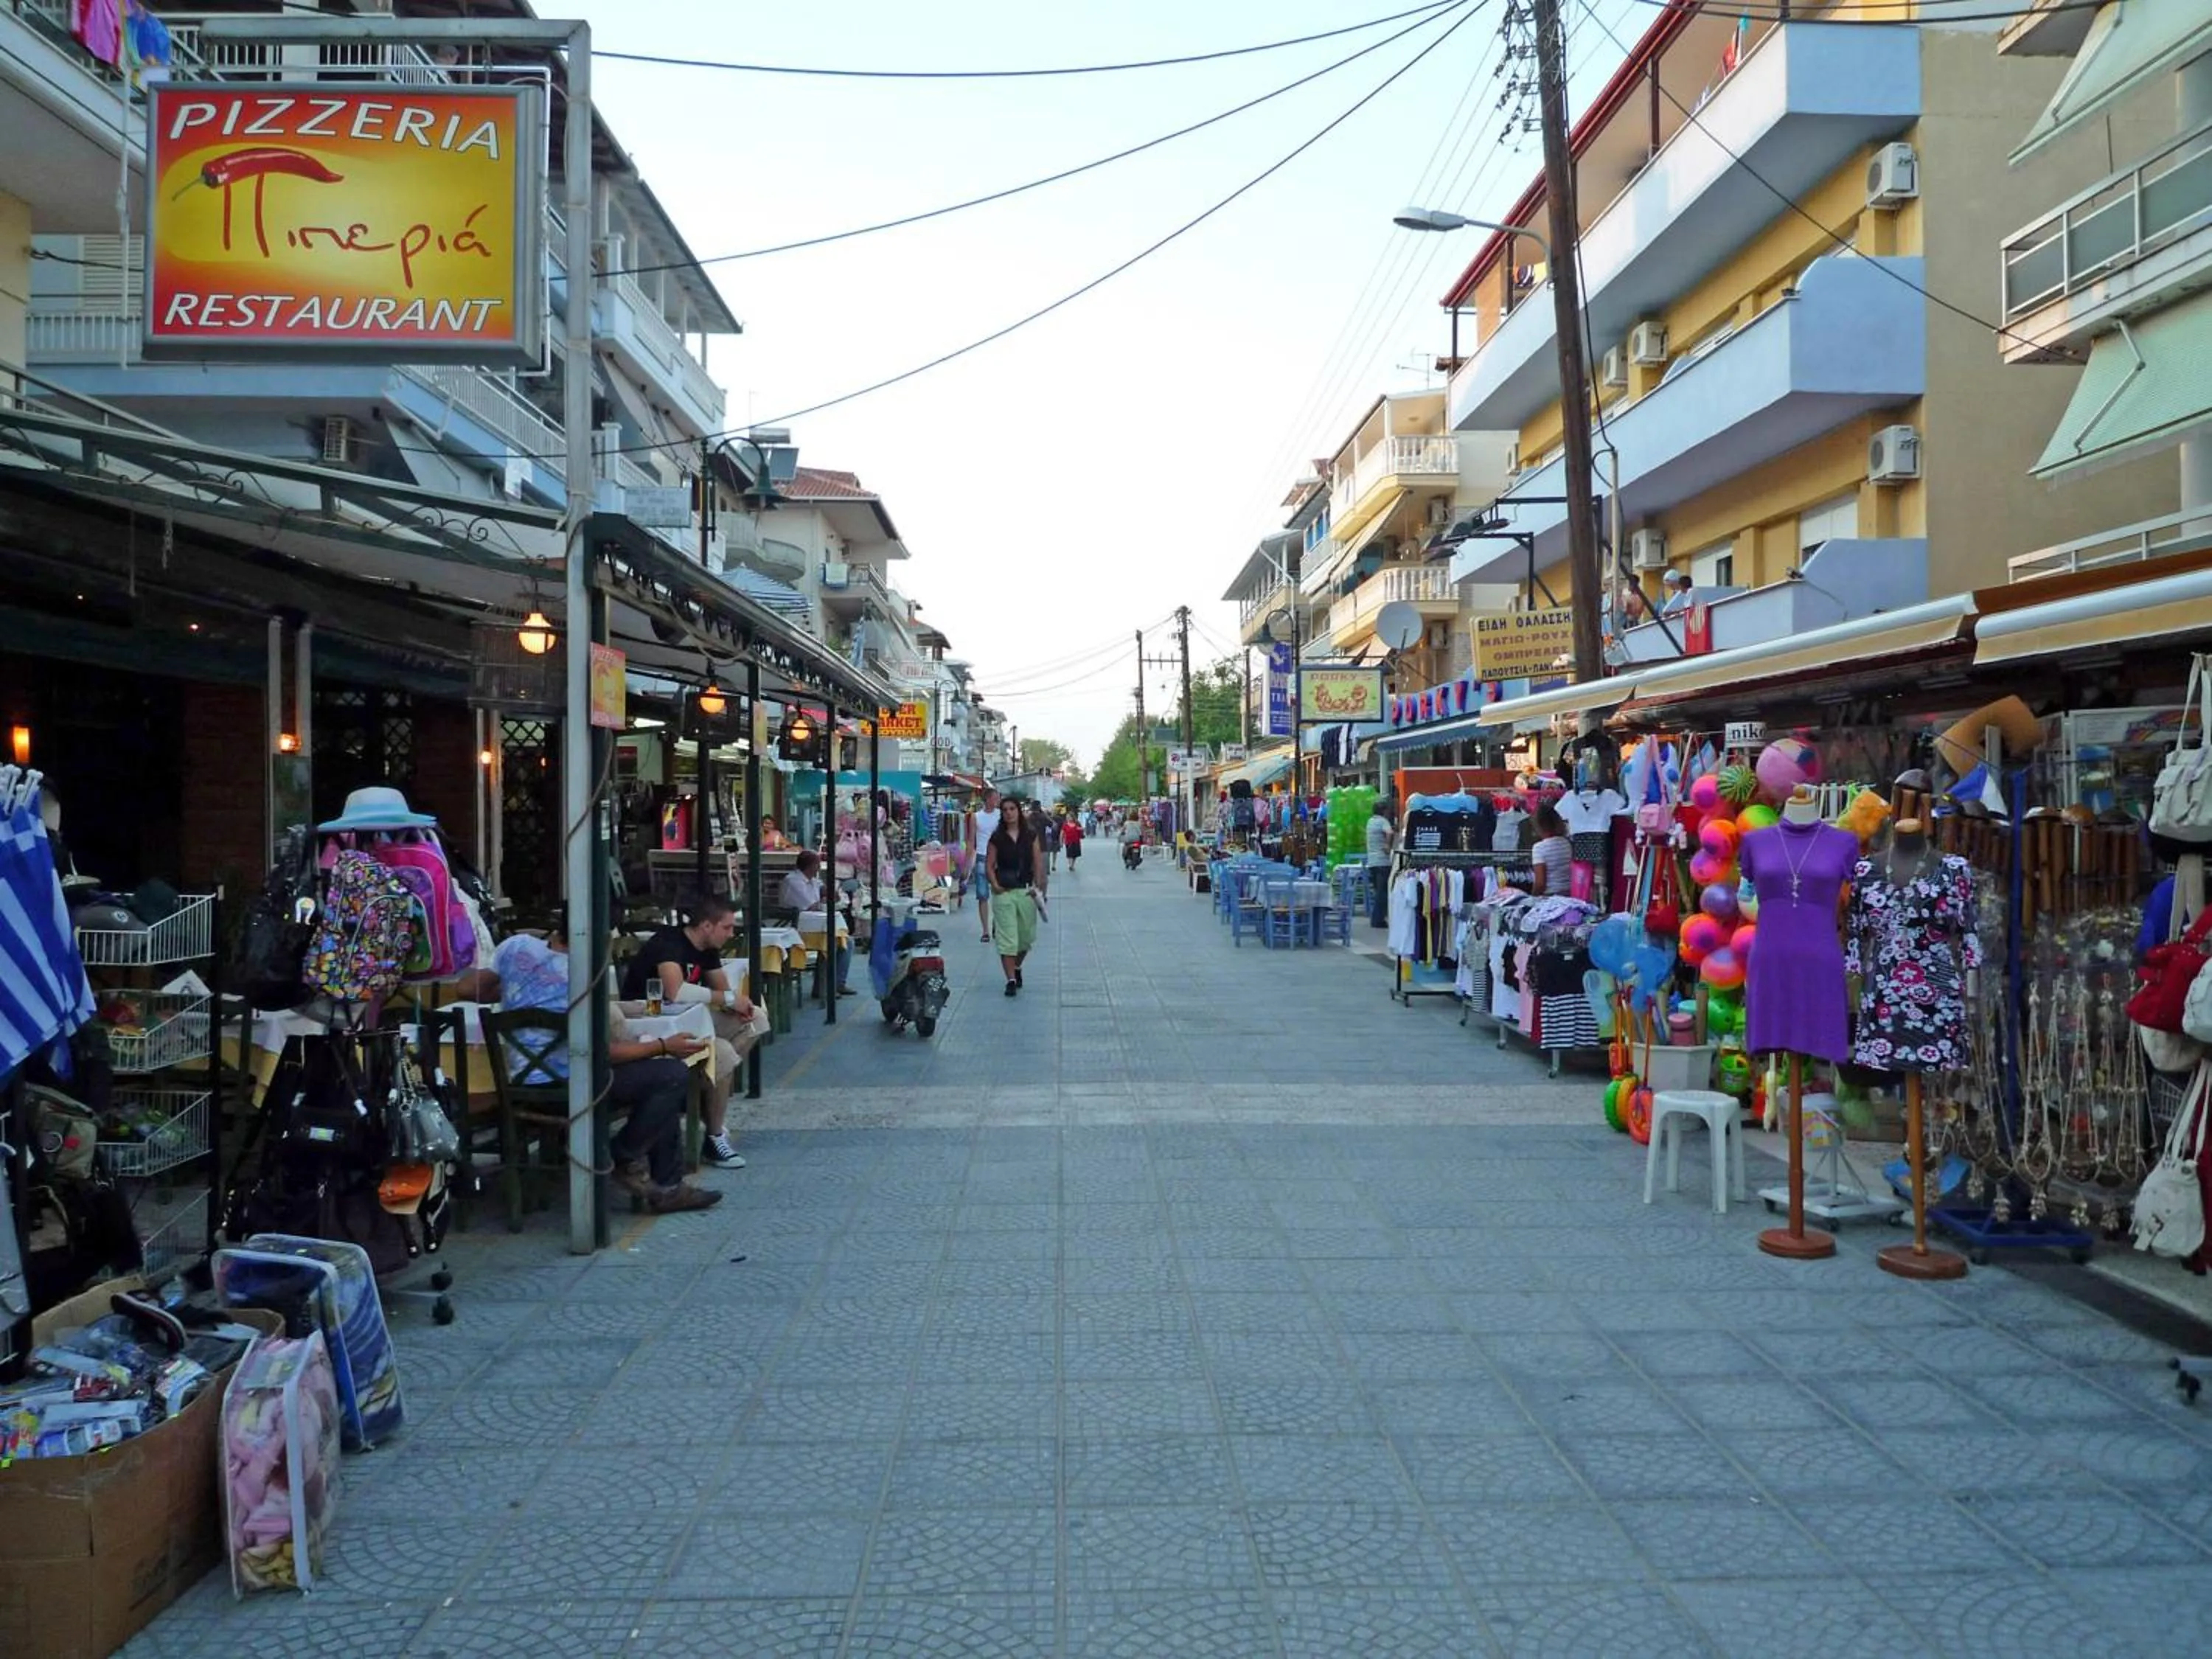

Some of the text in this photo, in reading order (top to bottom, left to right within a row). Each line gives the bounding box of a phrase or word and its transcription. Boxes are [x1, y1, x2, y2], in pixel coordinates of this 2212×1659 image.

[170, 98, 501, 161] PIZZERIA
[164, 293, 503, 332] RESTAURANT
[1478, 618, 1507, 632] ΕΙΔΗ
[877, 716, 922, 728] ARKET
